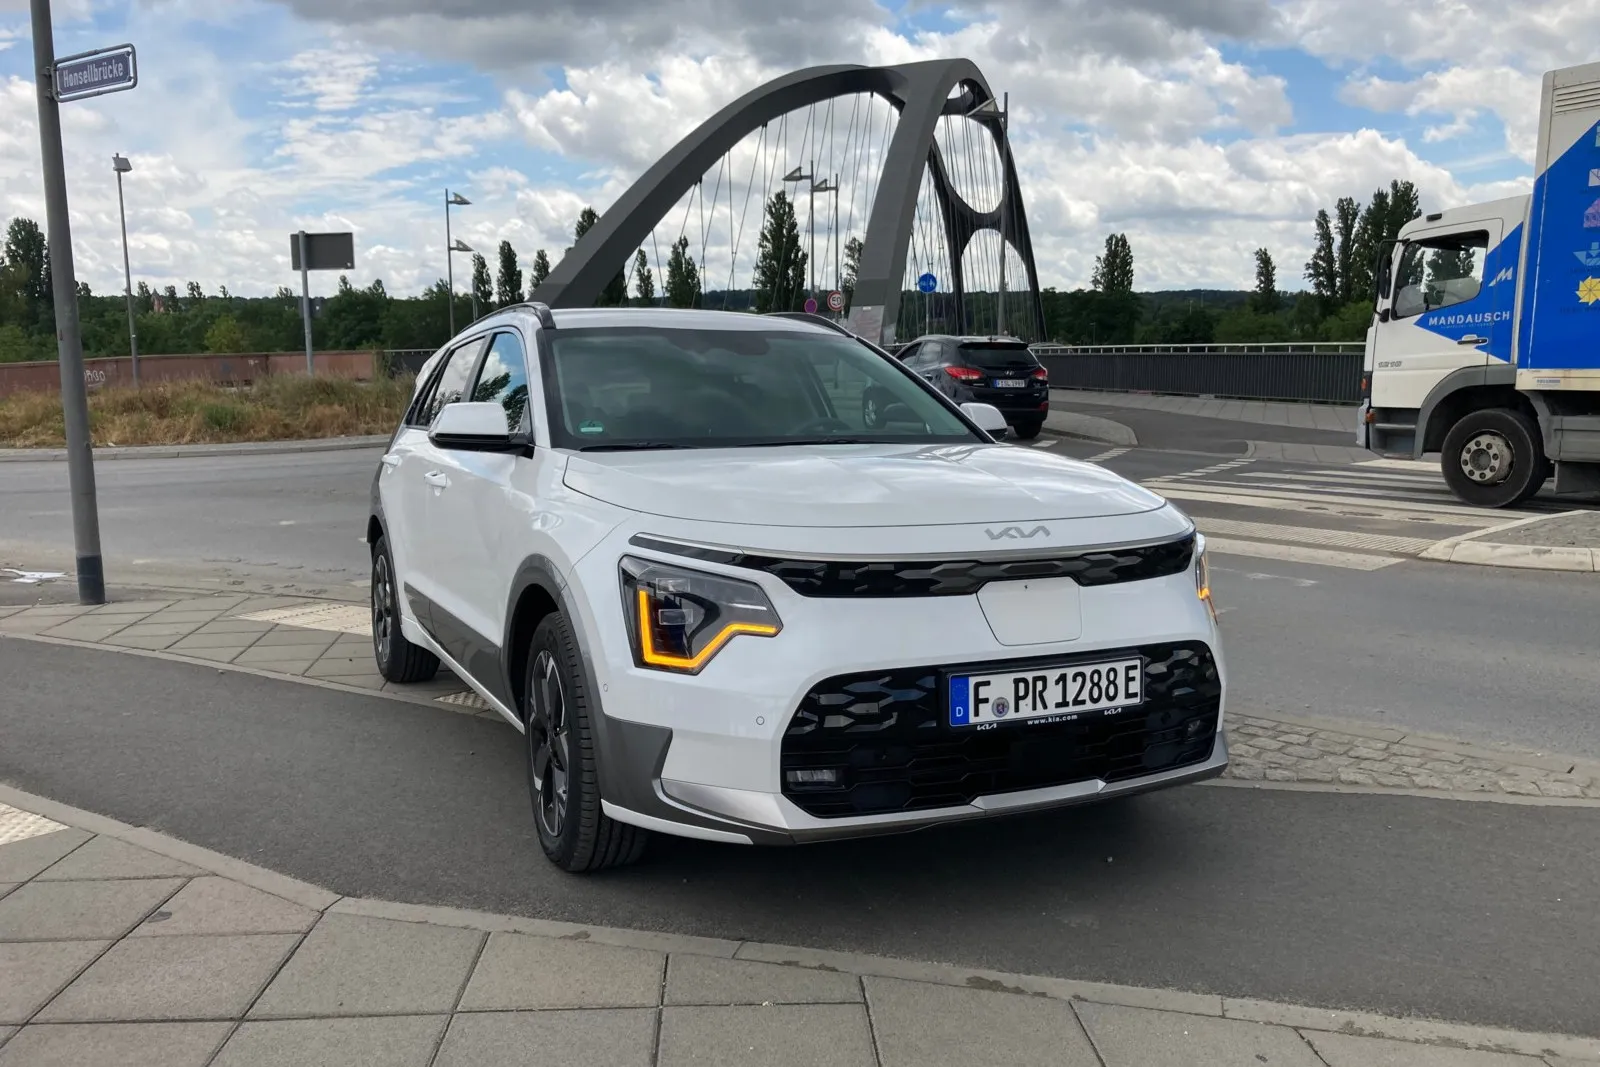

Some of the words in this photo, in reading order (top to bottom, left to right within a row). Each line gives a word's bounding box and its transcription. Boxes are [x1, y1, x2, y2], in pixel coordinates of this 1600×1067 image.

[63, 59, 123, 88] Honsellbrücke
[1428, 310, 1510, 326] MANDAUSCH
[973, 680, 991, 717] F
[955, 706, 964, 717] D
[1027, 714, 1078, 725] www.kia.com
